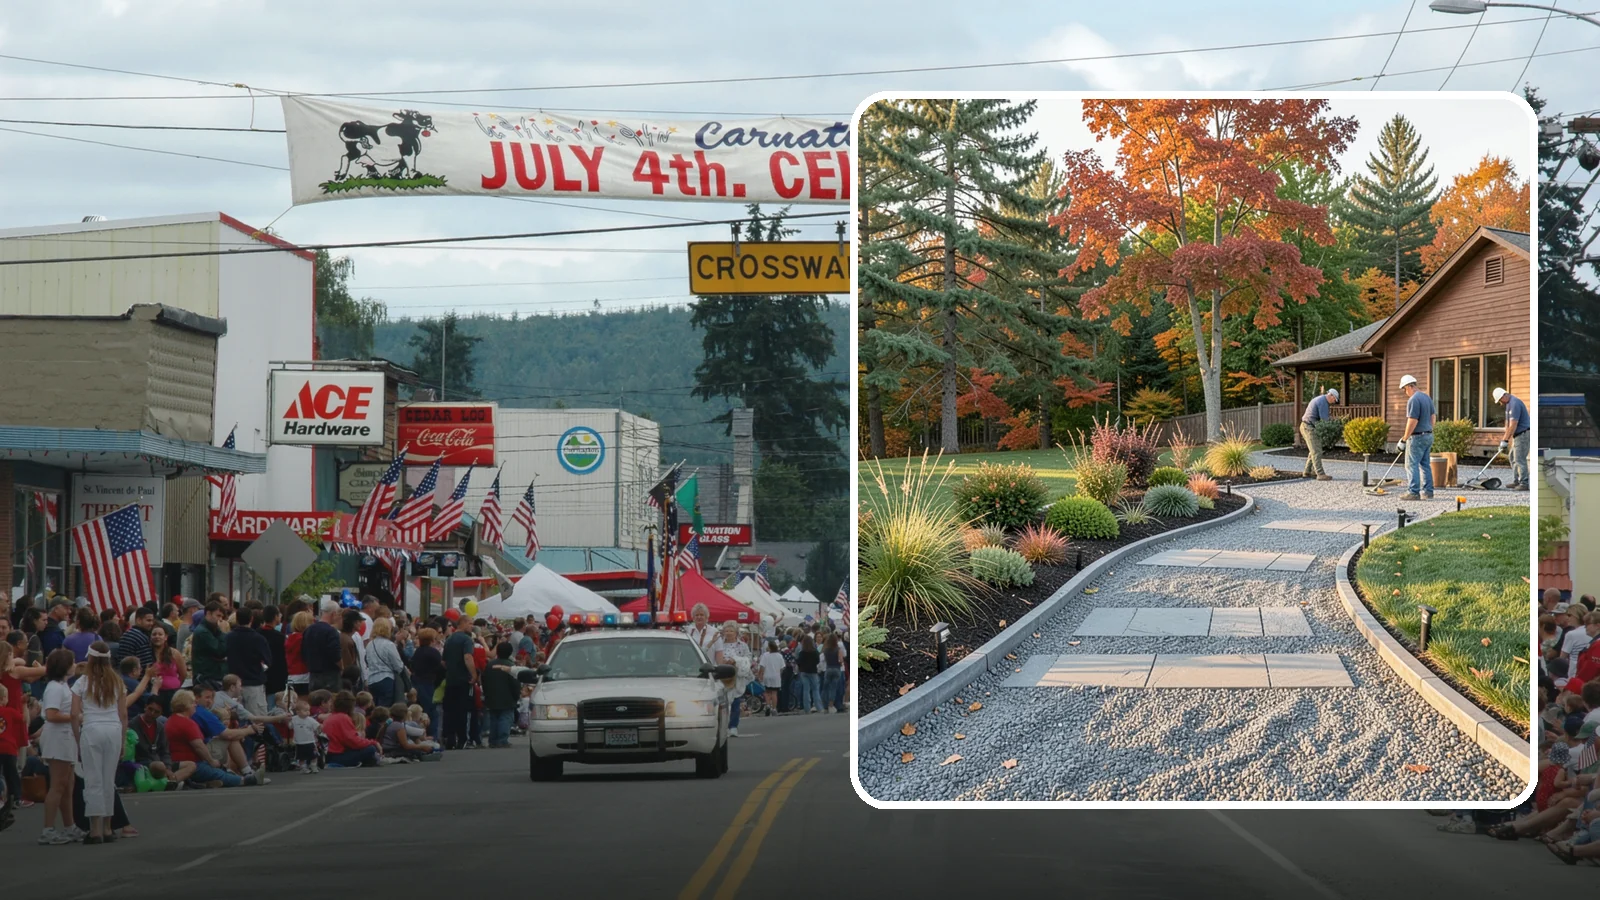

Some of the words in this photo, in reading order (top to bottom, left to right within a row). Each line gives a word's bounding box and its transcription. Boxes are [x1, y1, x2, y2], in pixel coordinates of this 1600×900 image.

[694, 121, 850, 150] Carnat
[481, 141, 604, 192] JULY
[632, 150, 746, 198] 4th.
[697, 254, 850, 280] CROSSWA
[282, 380, 373, 420] ACE
[406, 409, 452, 421] CEDAR
[283, 421, 371, 436] Hardware
[416, 428, 477, 447] Coca-Cola
[353, 467, 385, 480] Simpl
[83, 485, 94, 493] St.
[96, 485, 124, 494] Vincent
[126, 486, 136, 494] de
[137, 486, 155, 495] Paul
[81, 503, 154, 522] THT
[212, 516, 330, 535] HARDARE
[688, 526, 741, 535] CRNATION
[699, 535, 730, 543] GLASS
